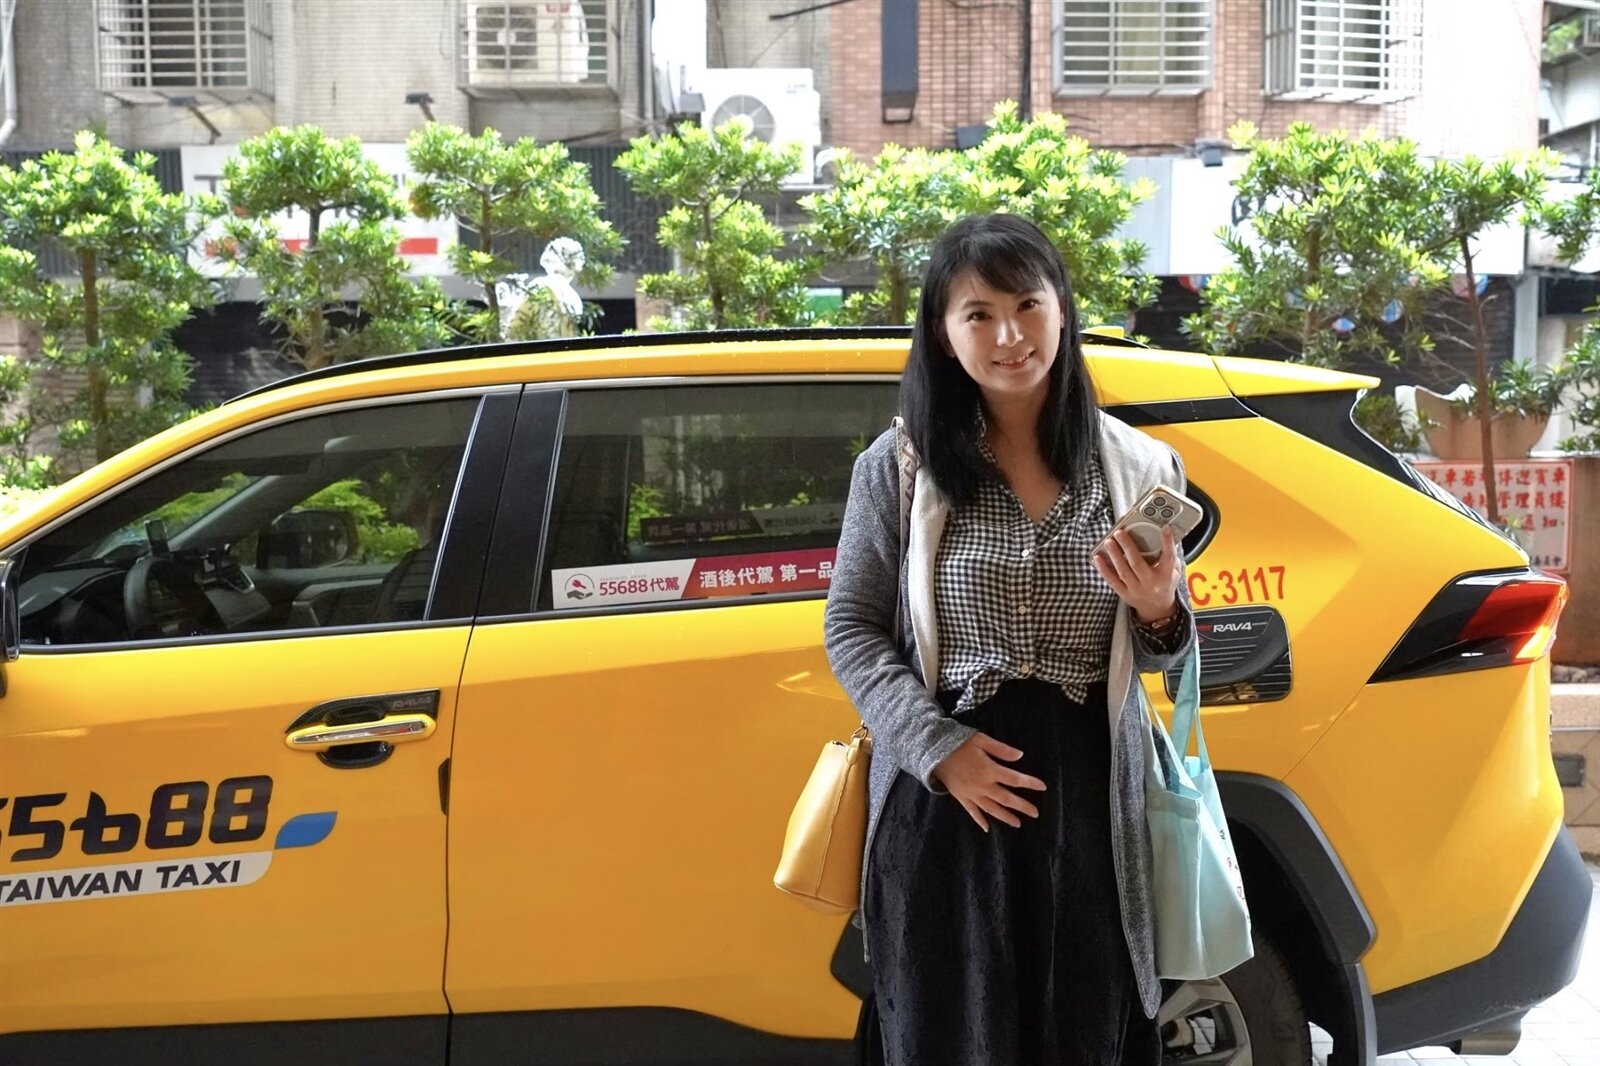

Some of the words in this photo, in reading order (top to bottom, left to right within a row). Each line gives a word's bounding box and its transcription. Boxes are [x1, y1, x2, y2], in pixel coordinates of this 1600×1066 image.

[599, 576, 680, 596] 55688代駕
[699, 564, 775, 588] 酒後代駕
[779, 560, 835, 583] 第一品
[1187, 565, 1286, 606] C-3117
[1213, 621, 1253, 633] RAV4
[0, 774, 274, 863] 5688
[156, 859, 241, 889] TAXI
